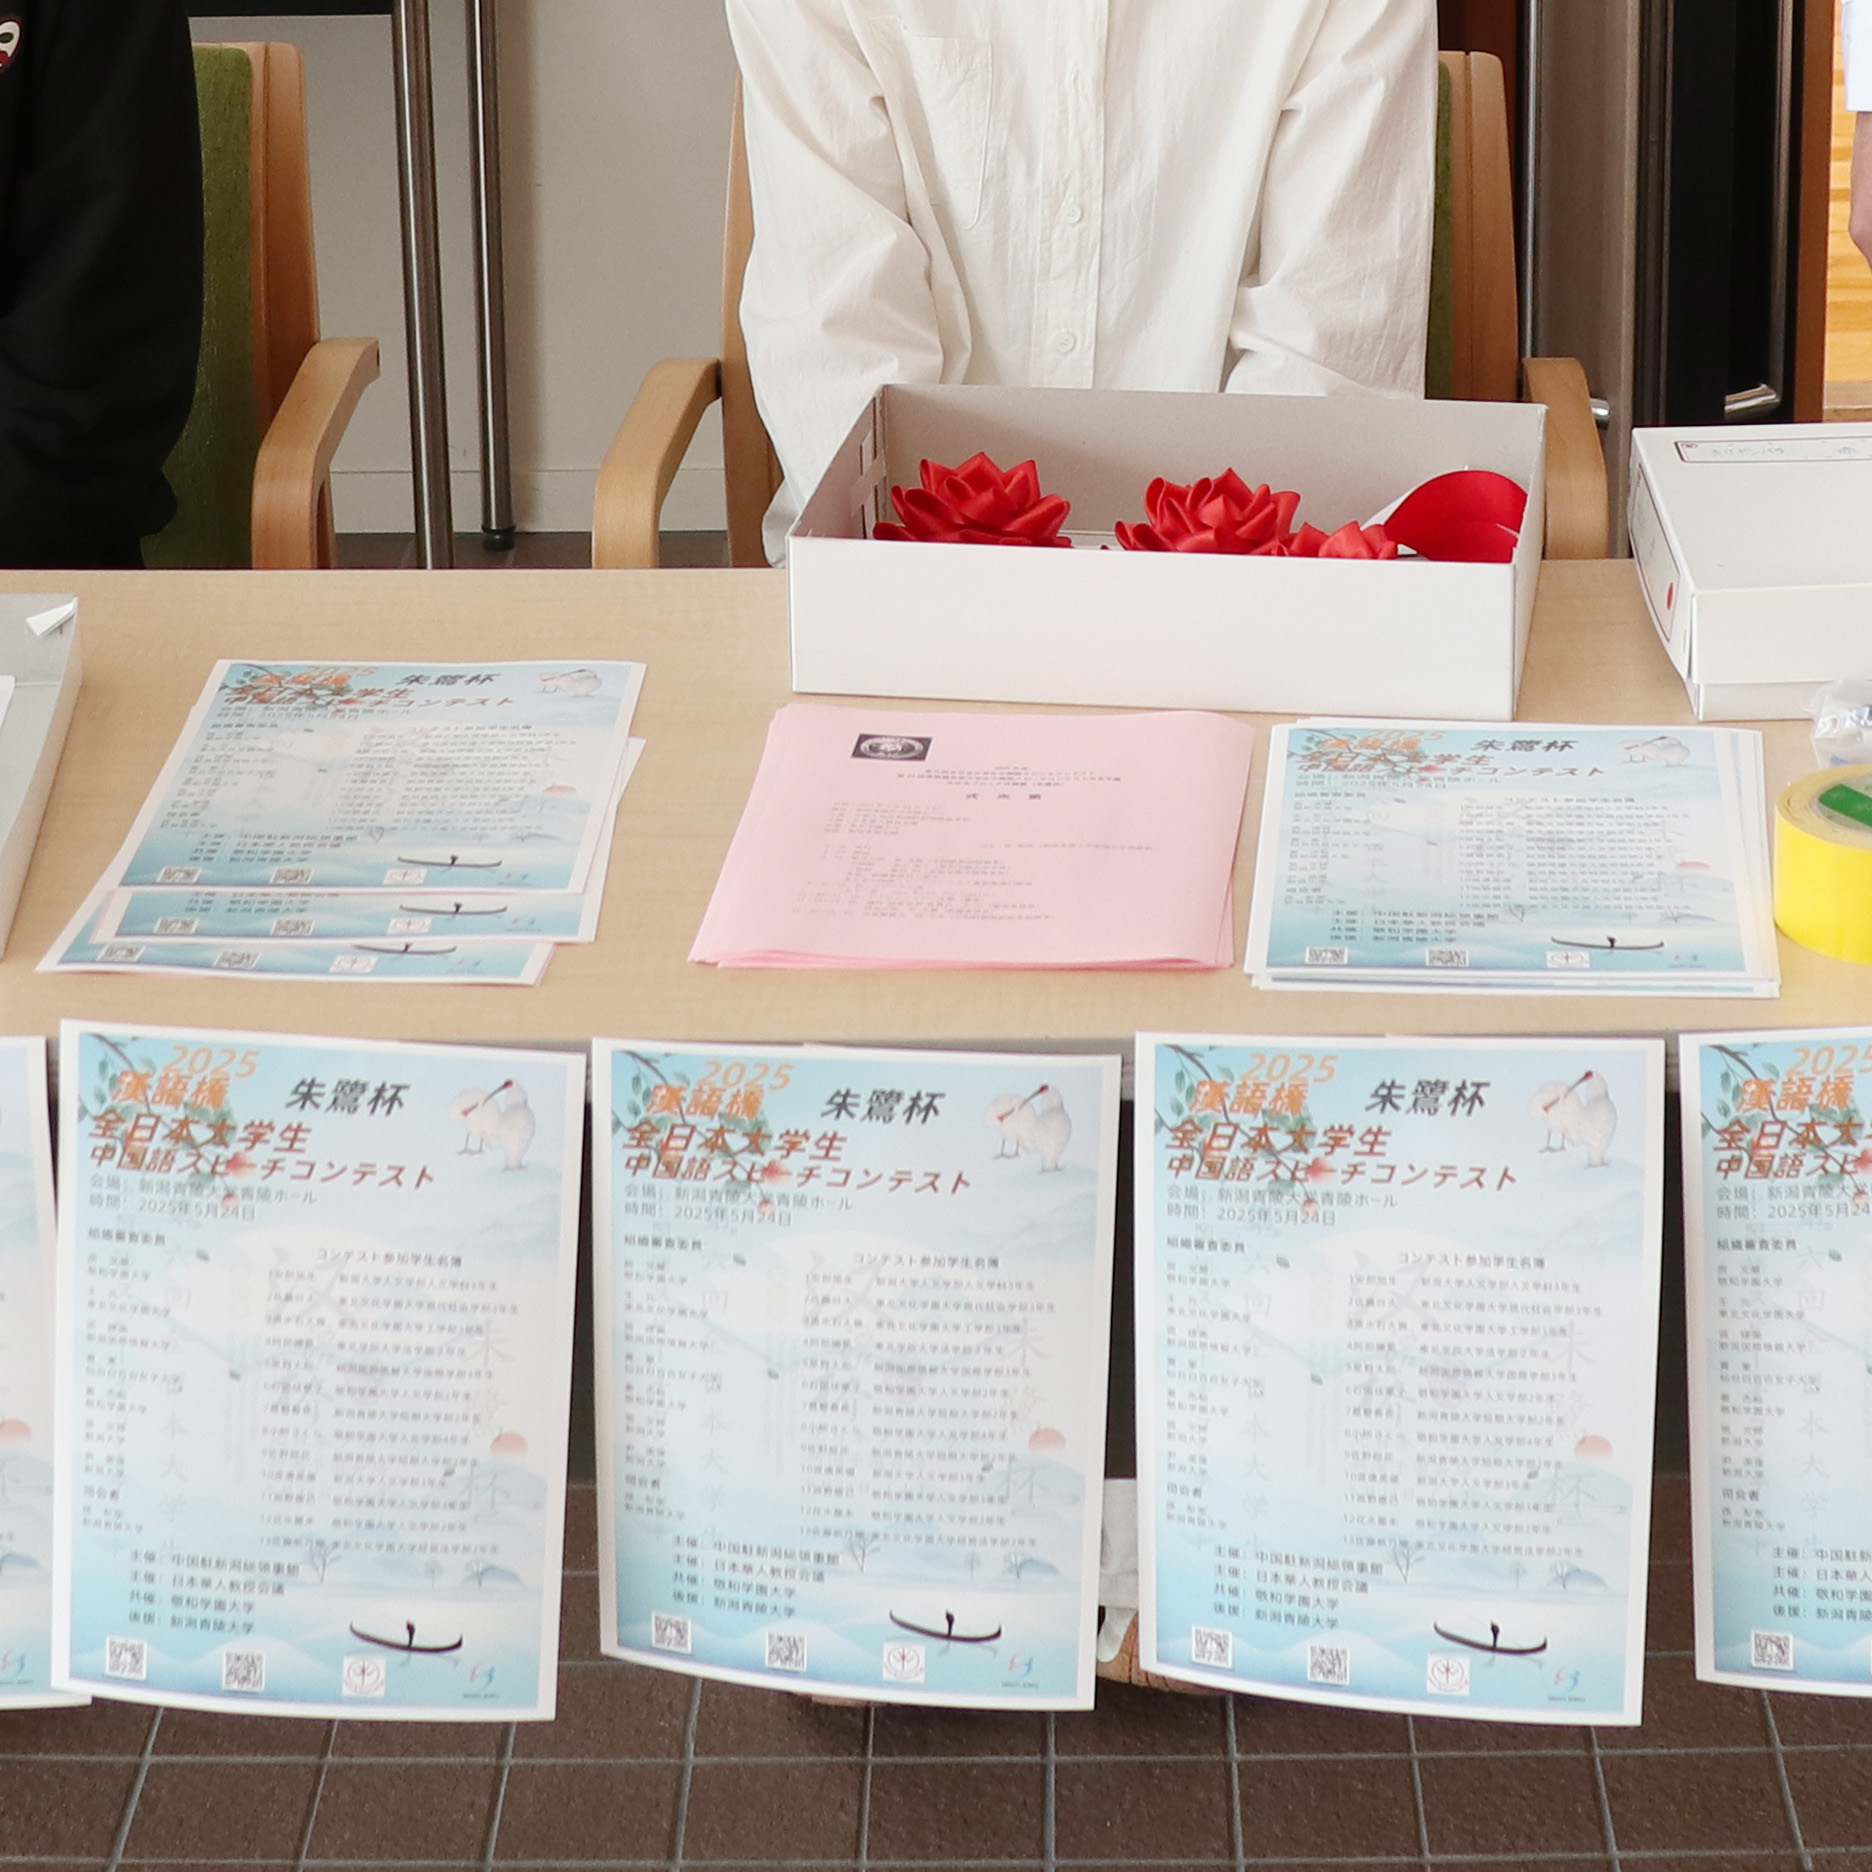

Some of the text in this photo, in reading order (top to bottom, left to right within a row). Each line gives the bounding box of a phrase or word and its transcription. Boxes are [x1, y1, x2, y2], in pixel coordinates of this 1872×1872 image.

[162, 1045, 259, 1078] 2025
[696, 1059, 794, 1089] 2025
[1240, 1053, 1338, 1082] 2025
[112, 1070, 409, 1119] 漢語橋 朱鷺杯
[646, 1084, 944, 1126] 漢語橋 朱鷺杯
[1189, 1078, 1489, 1117] 漢語橋 朱鷺杯
[1736, 1076, 1853, 1113] 漢語橋
[88, 1111, 312, 1155] 全日本大学生
[622, 1123, 847, 1163] 全日本大学生
[1165, 1121, 1392, 1159] 全日本大学生
[89, 1143, 436, 1193] 中国語スピーチコンテスト
[624, 1154, 972, 1197] 中国語スピーチコンテスト
[1166, 1154, 1517, 1192] 中国語スピーチコンテスト
